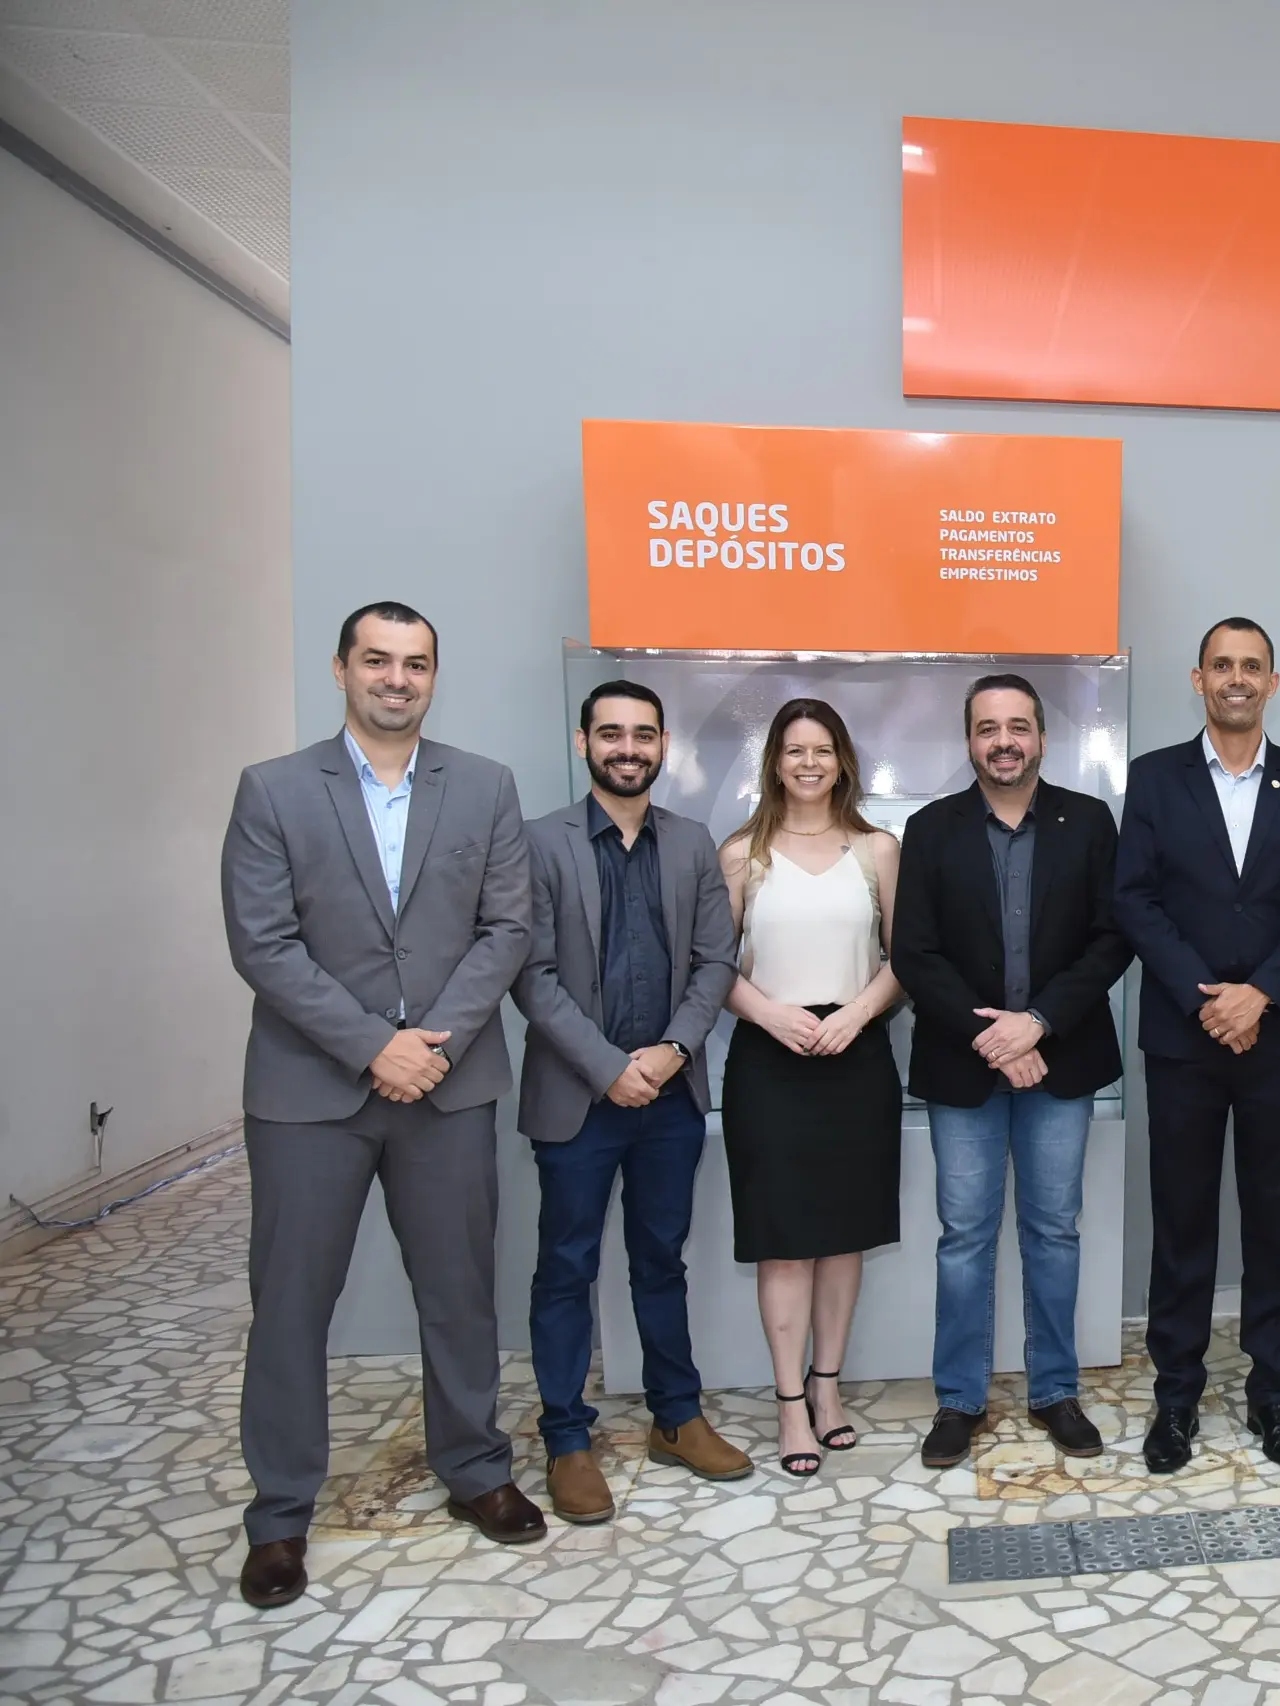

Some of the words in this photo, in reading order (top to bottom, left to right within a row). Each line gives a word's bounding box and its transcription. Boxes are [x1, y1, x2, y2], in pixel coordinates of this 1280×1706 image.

[647, 500, 790, 534] SAQUES
[939, 509, 985, 523] SALDO
[992, 511, 1057, 525] EXTRATO
[939, 528, 1036, 544] PAGAMENTOS
[649, 535, 847, 572] DEPÓSITOS
[939, 547, 1062, 564] TRANSFERÊNCIAS
[939, 566, 1039, 582] EMPRÉSTIMOS
